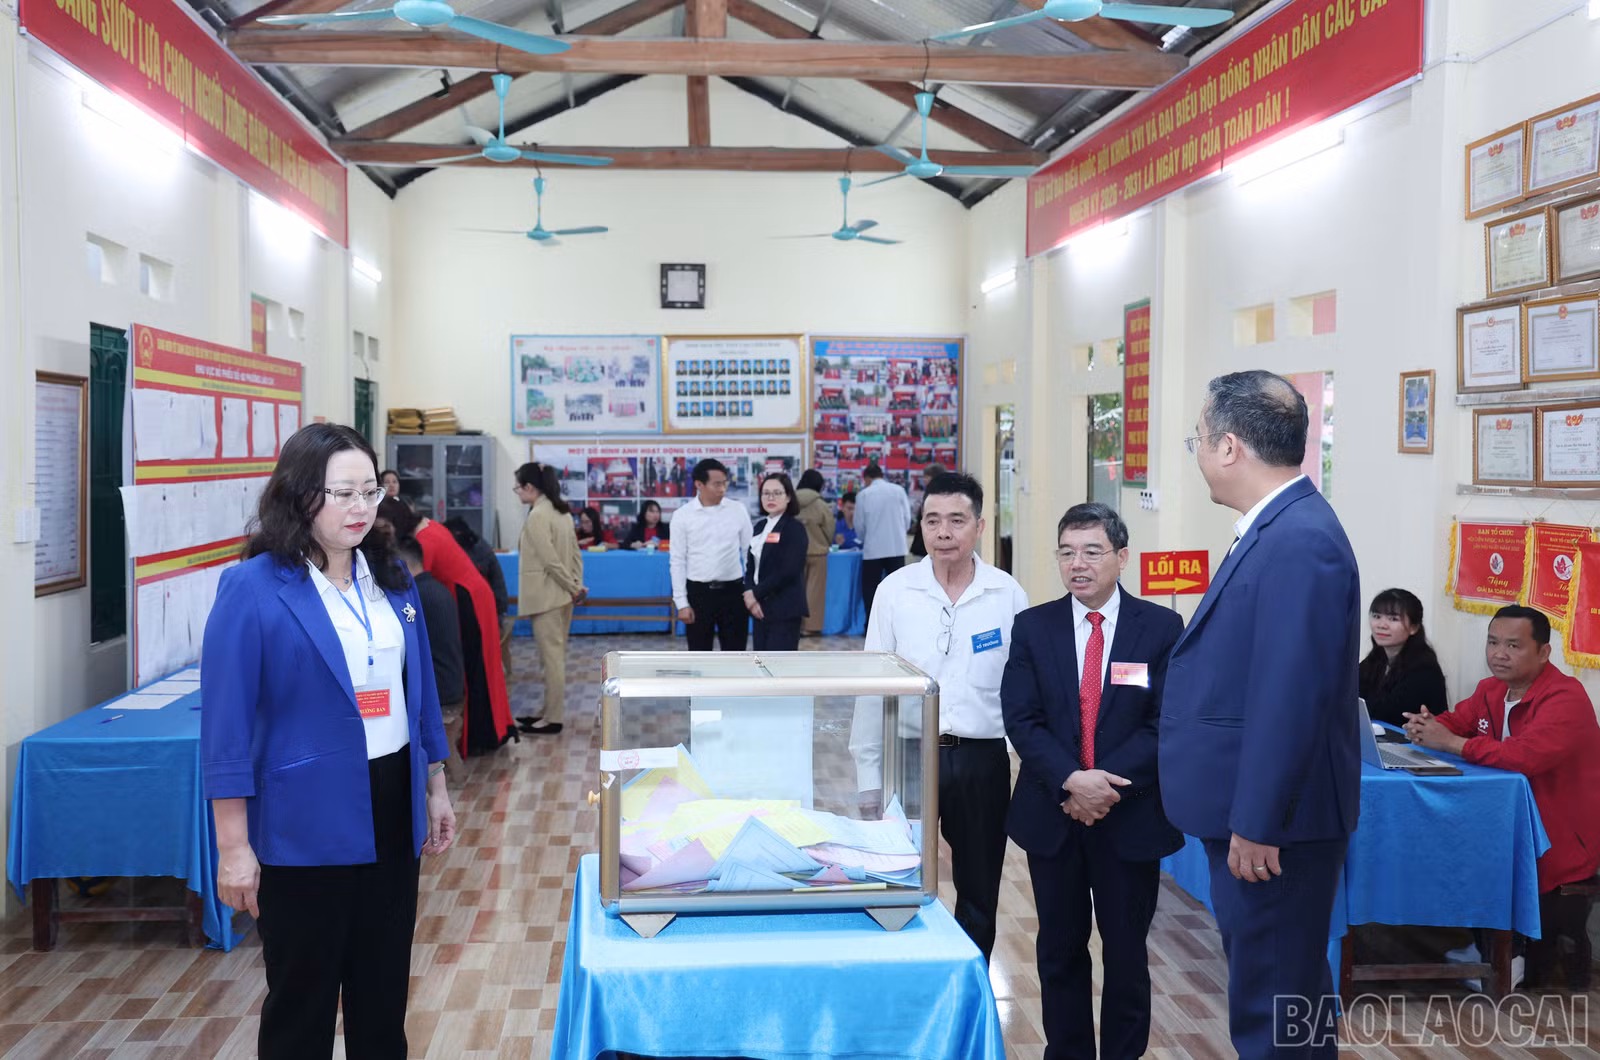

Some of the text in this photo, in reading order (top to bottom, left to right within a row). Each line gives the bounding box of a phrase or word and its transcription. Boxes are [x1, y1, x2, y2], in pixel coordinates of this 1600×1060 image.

[138, 16, 161, 90] LỰA
[164, 40, 193, 114] CHỌN
[1131, 125, 1145, 155] XVI
[1145, 112, 1158, 145] VÀ
[1158, 105, 1175, 140] ĐẠI
[1175, 82, 1198, 129] BIỂU
[1199, 75, 1218, 116] HỘI
[1220, 57, 1250, 103] ĐỒNG
[1253, 34, 1289, 83] NHÂN
[1292, 12, 1321, 60] DÂN
[1124, 168, 1142, 200] 2031
[1144, 156, 1155, 190] LÀ
[1156, 145, 1180, 185] NGÀY
[1182, 133, 1198, 174] HỘI
[1200, 117, 1221, 161] CỦA
[1224, 106, 1253, 150] TOÀN
[1256, 91, 1281, 134] DÂN
[1285, 86, 1290, 119] !
[1148, 554, 1202, 576] LỐI RA
[1488, 575, 1509, 588] Tặng
